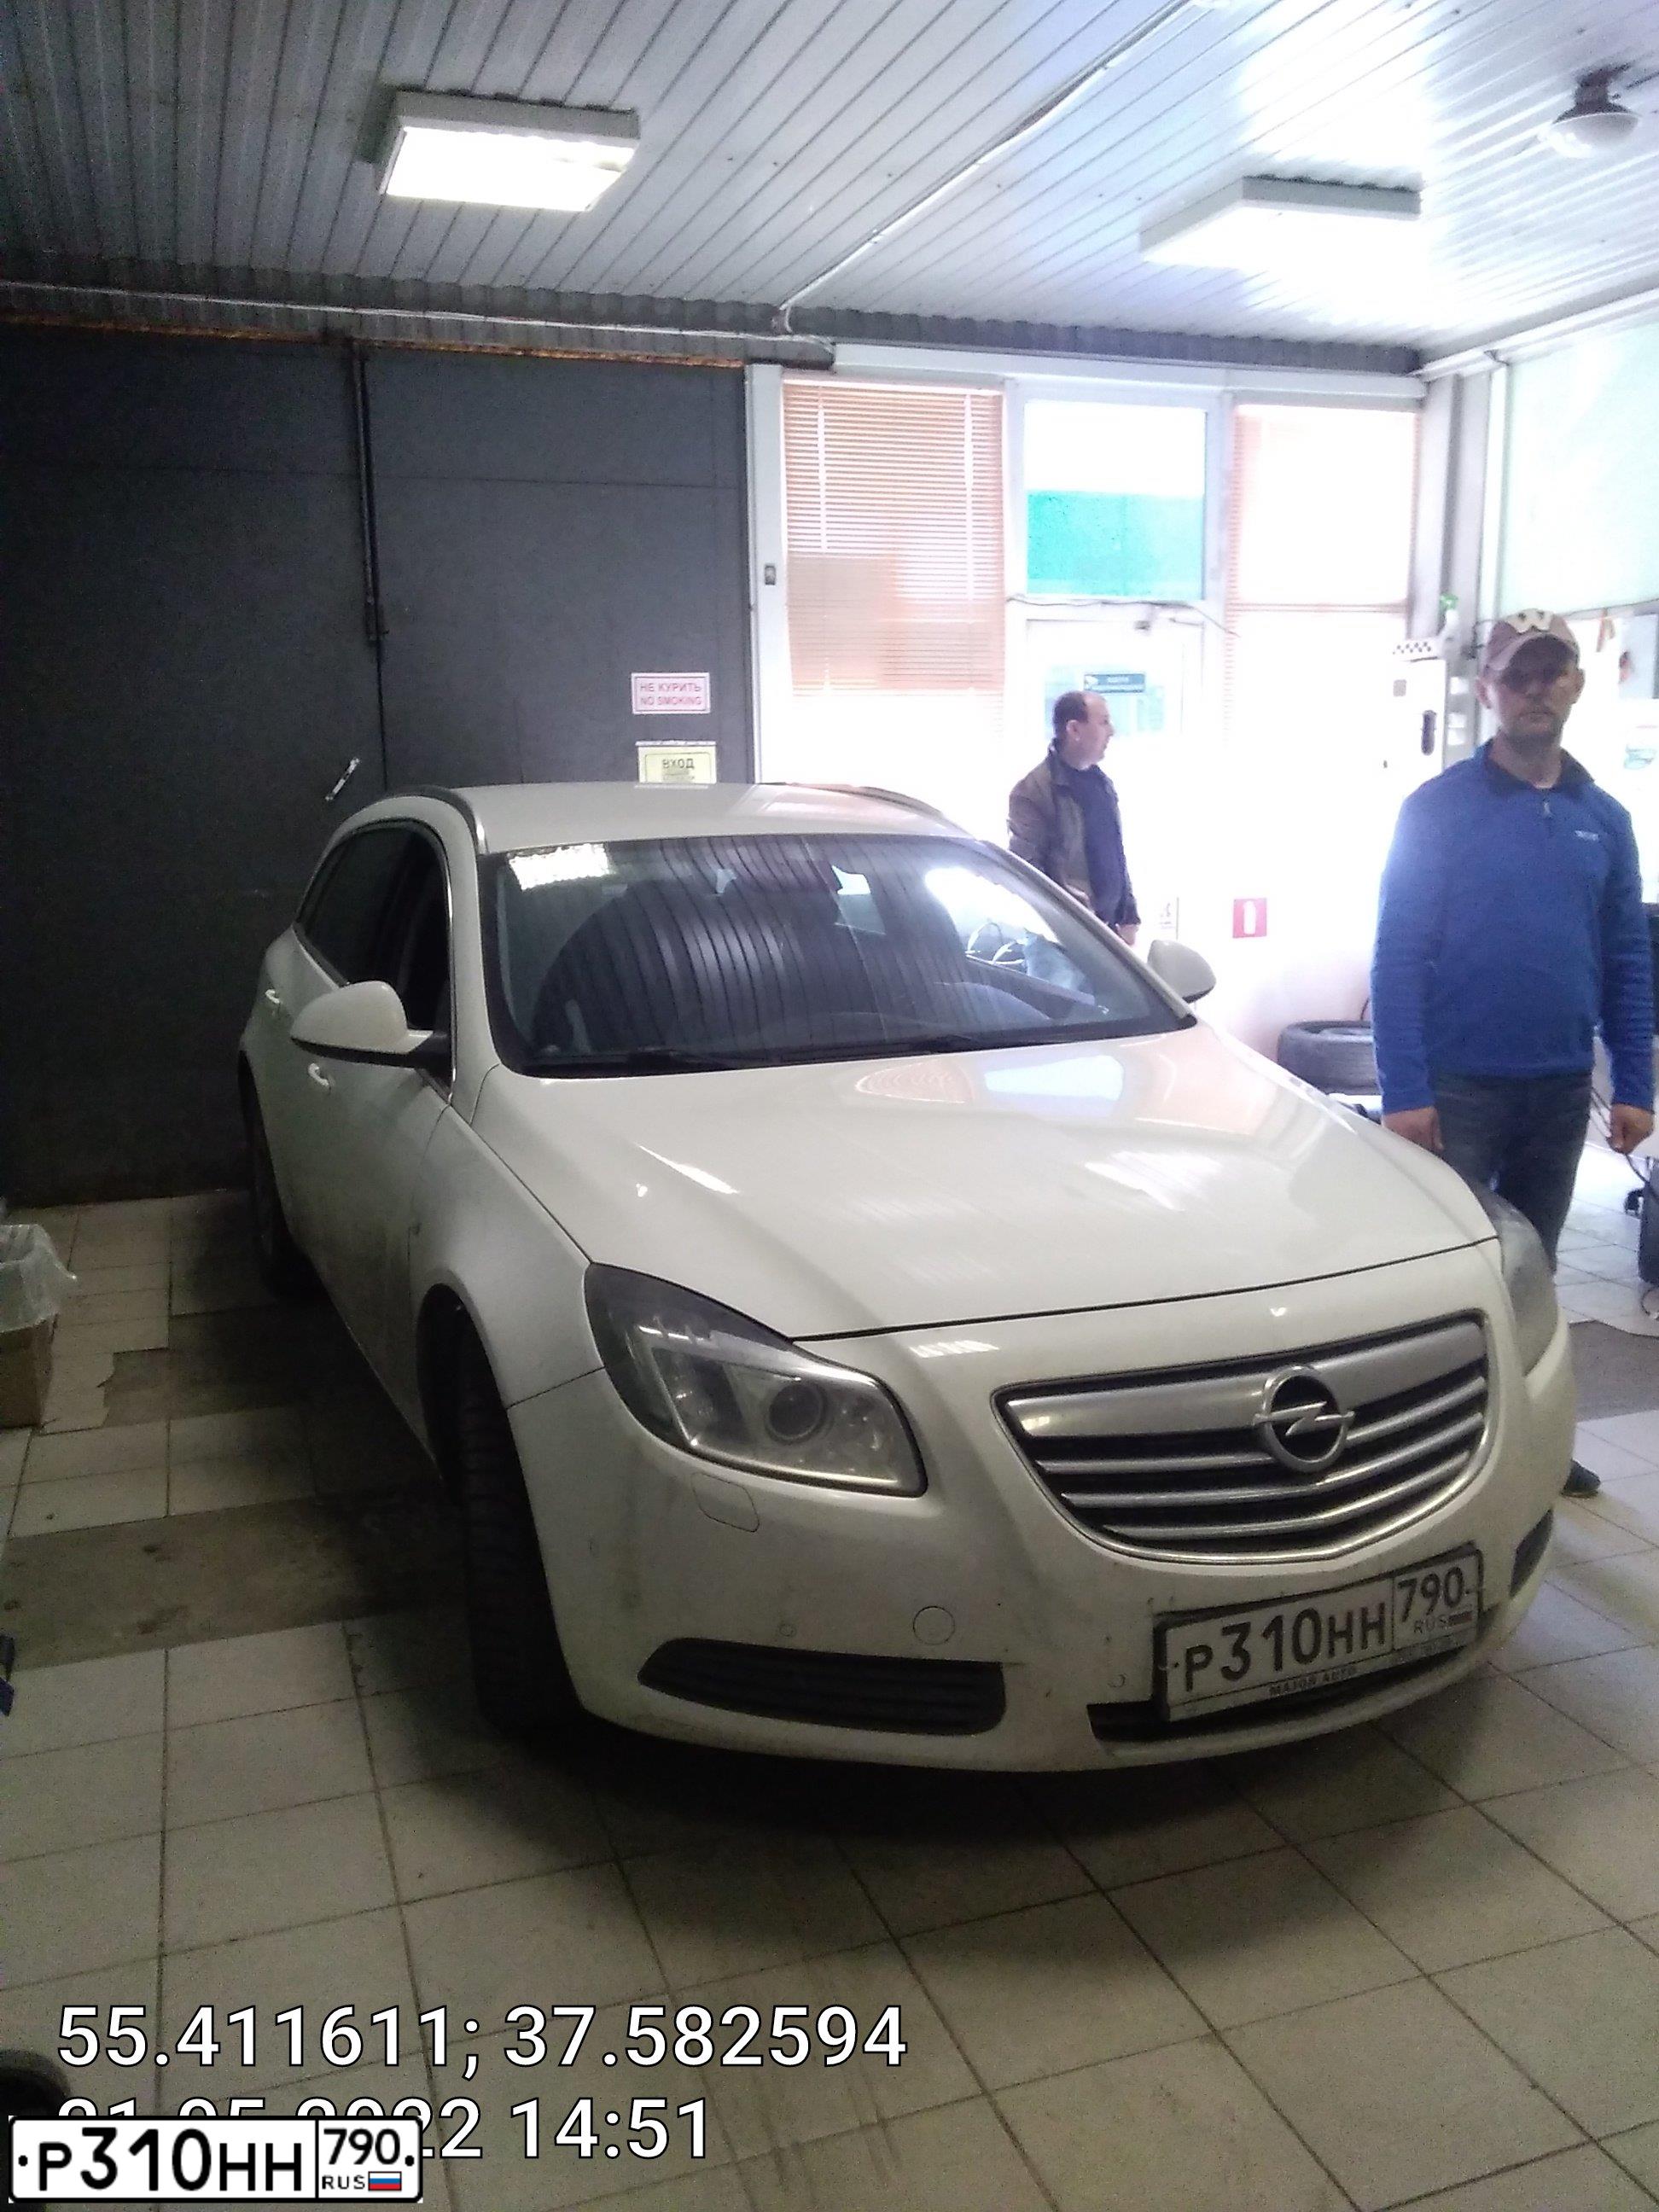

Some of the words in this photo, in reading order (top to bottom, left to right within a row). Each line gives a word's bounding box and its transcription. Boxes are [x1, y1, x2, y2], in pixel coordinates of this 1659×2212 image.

[640, 683, 655, 692] НЕ
[658, 683, 701, 692] КУРИТЬ
[641, 696, 655, 706] NO
[657, 696, 702, 706] SMOKING
[661, 758, 695, 769] ВХОД
[1397, 1566, 1464, 1623] 790
[1413, 1614, 1448, 1634] RUS
